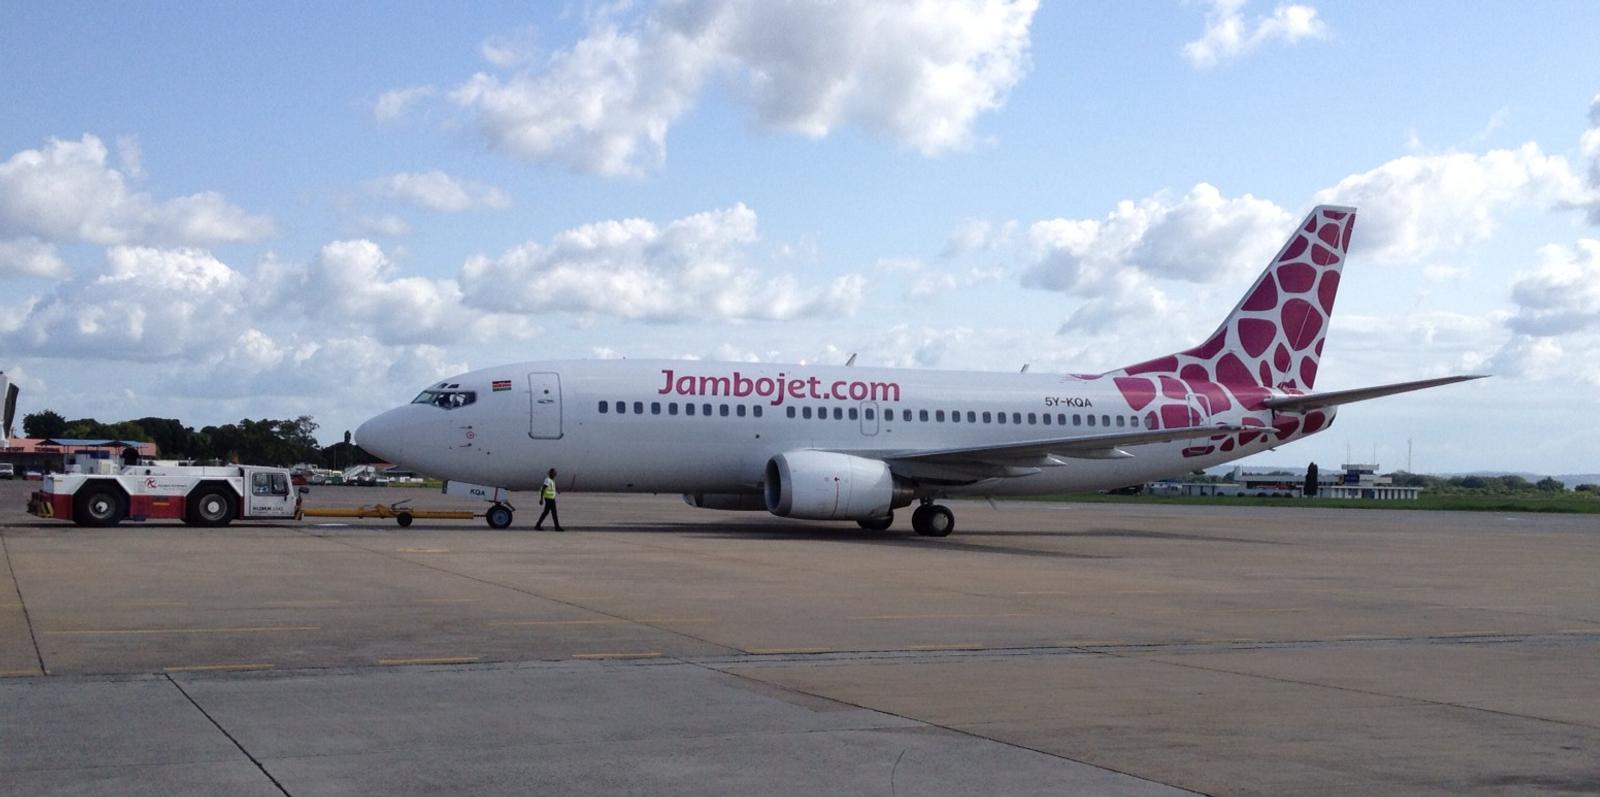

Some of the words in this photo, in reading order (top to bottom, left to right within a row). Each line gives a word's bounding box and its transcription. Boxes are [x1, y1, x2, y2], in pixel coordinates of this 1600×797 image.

[658, 369, 900, 406] Jambojet.com
[1045, 396, 1093, 408] 5Y-KQA
[470, 488, 485, 497] KQA
